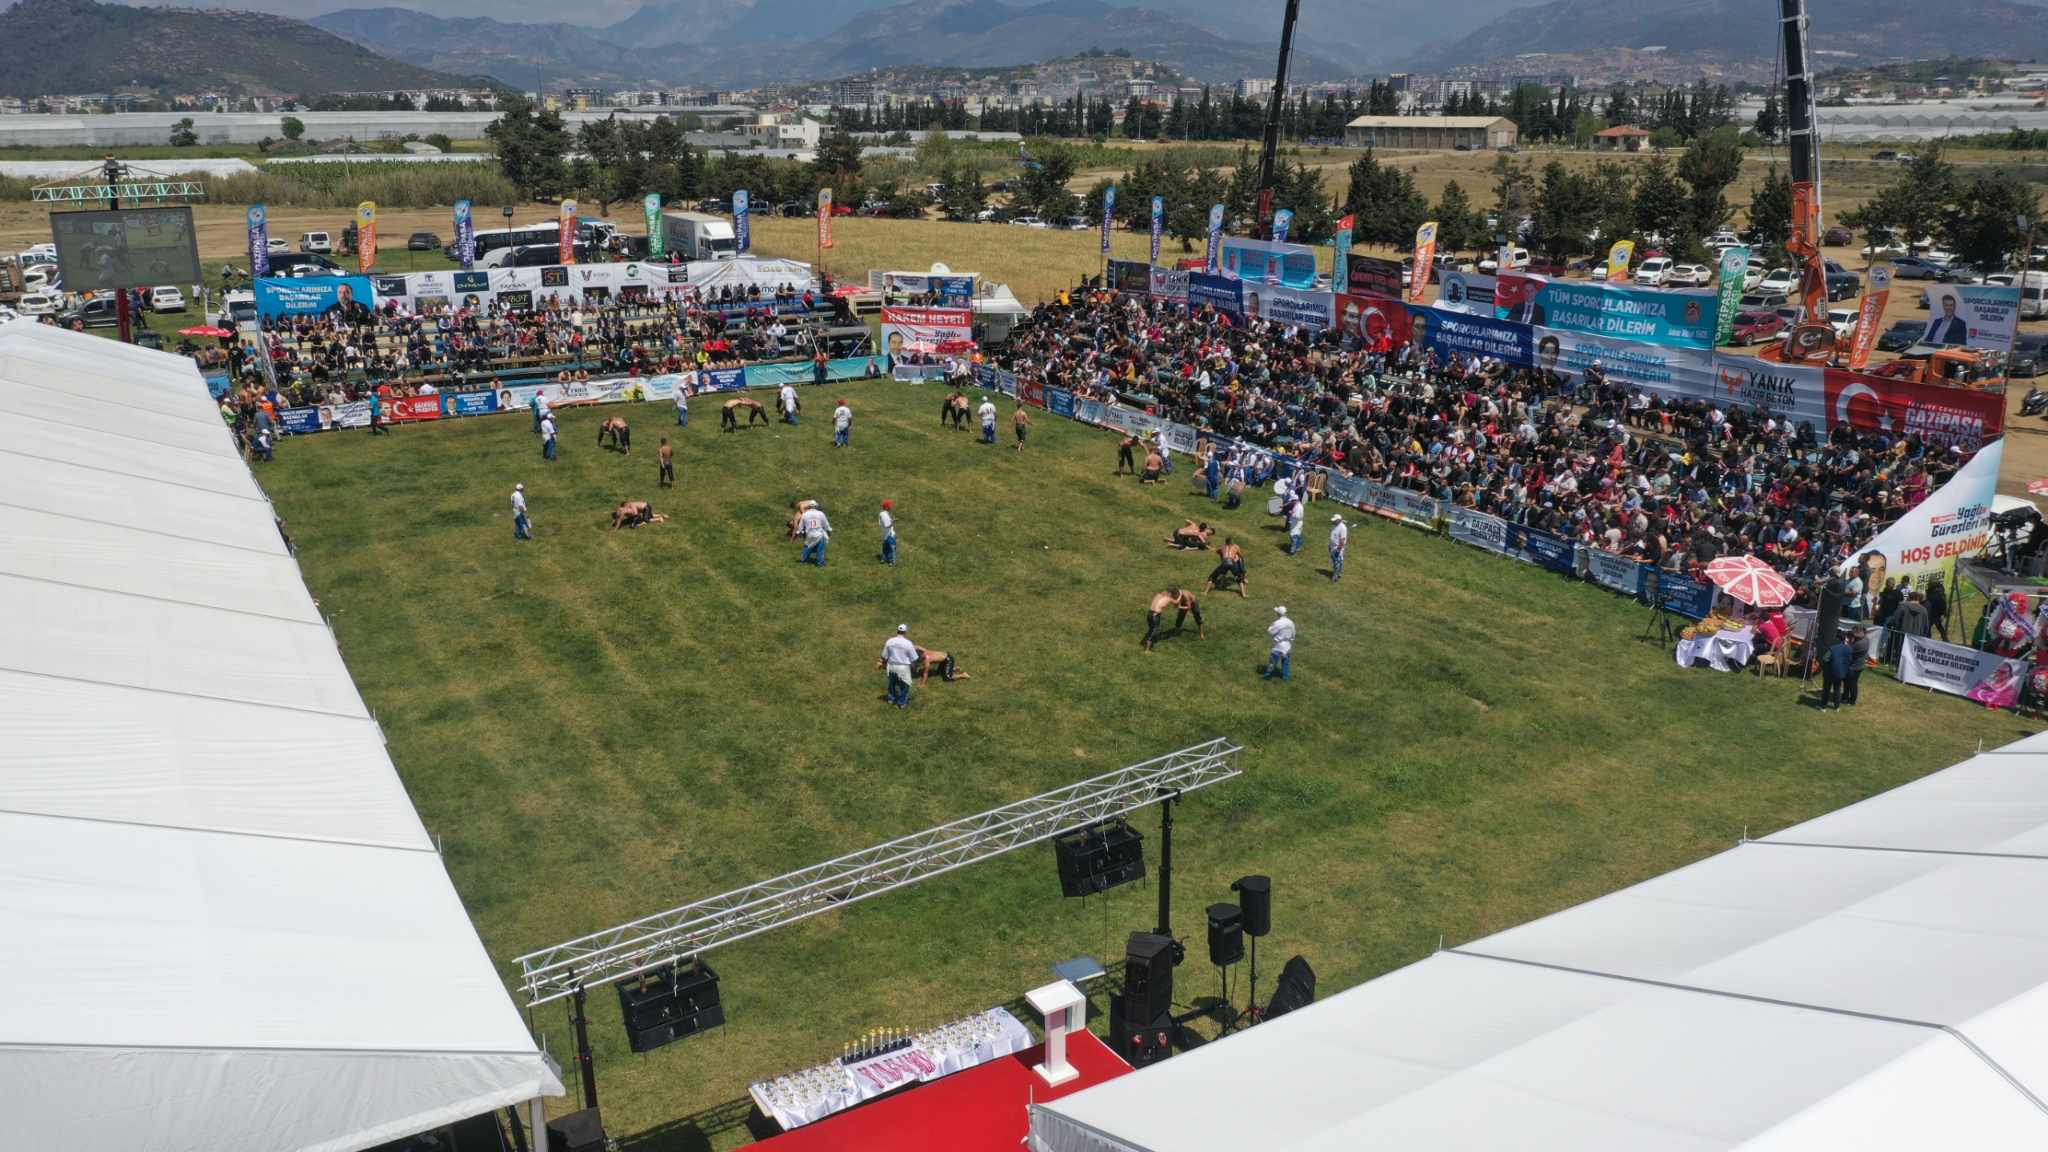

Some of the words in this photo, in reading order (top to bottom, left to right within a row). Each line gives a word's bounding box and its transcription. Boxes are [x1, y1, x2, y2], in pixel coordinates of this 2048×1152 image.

[1549, 290, 1570, 303] TÜM
[1572, 294, 1666, 317] SPORCULARIMIZA
[929, 313, 965, 325] HEYETİ
[1552, 311, 1604, 329] BAŞARILAR
[1607, 319, 1656, 336] DİLERİM
[1441, 320, 1518, 343] SPORCULARIMIZA
[1436, 331, 1484, 350] BAŞARILAR
[1484, 339, 1523, 358] DİLERİM
[1750, 372, 1796, 394] YANIK
[1766, 392, 1796, 406] BETON
[1957, 504, 1984, 520] Yağlı
[1900, 545, 1930, 565] HOŞ
[1934, 532, 1987, 559] GELDİNİZ
